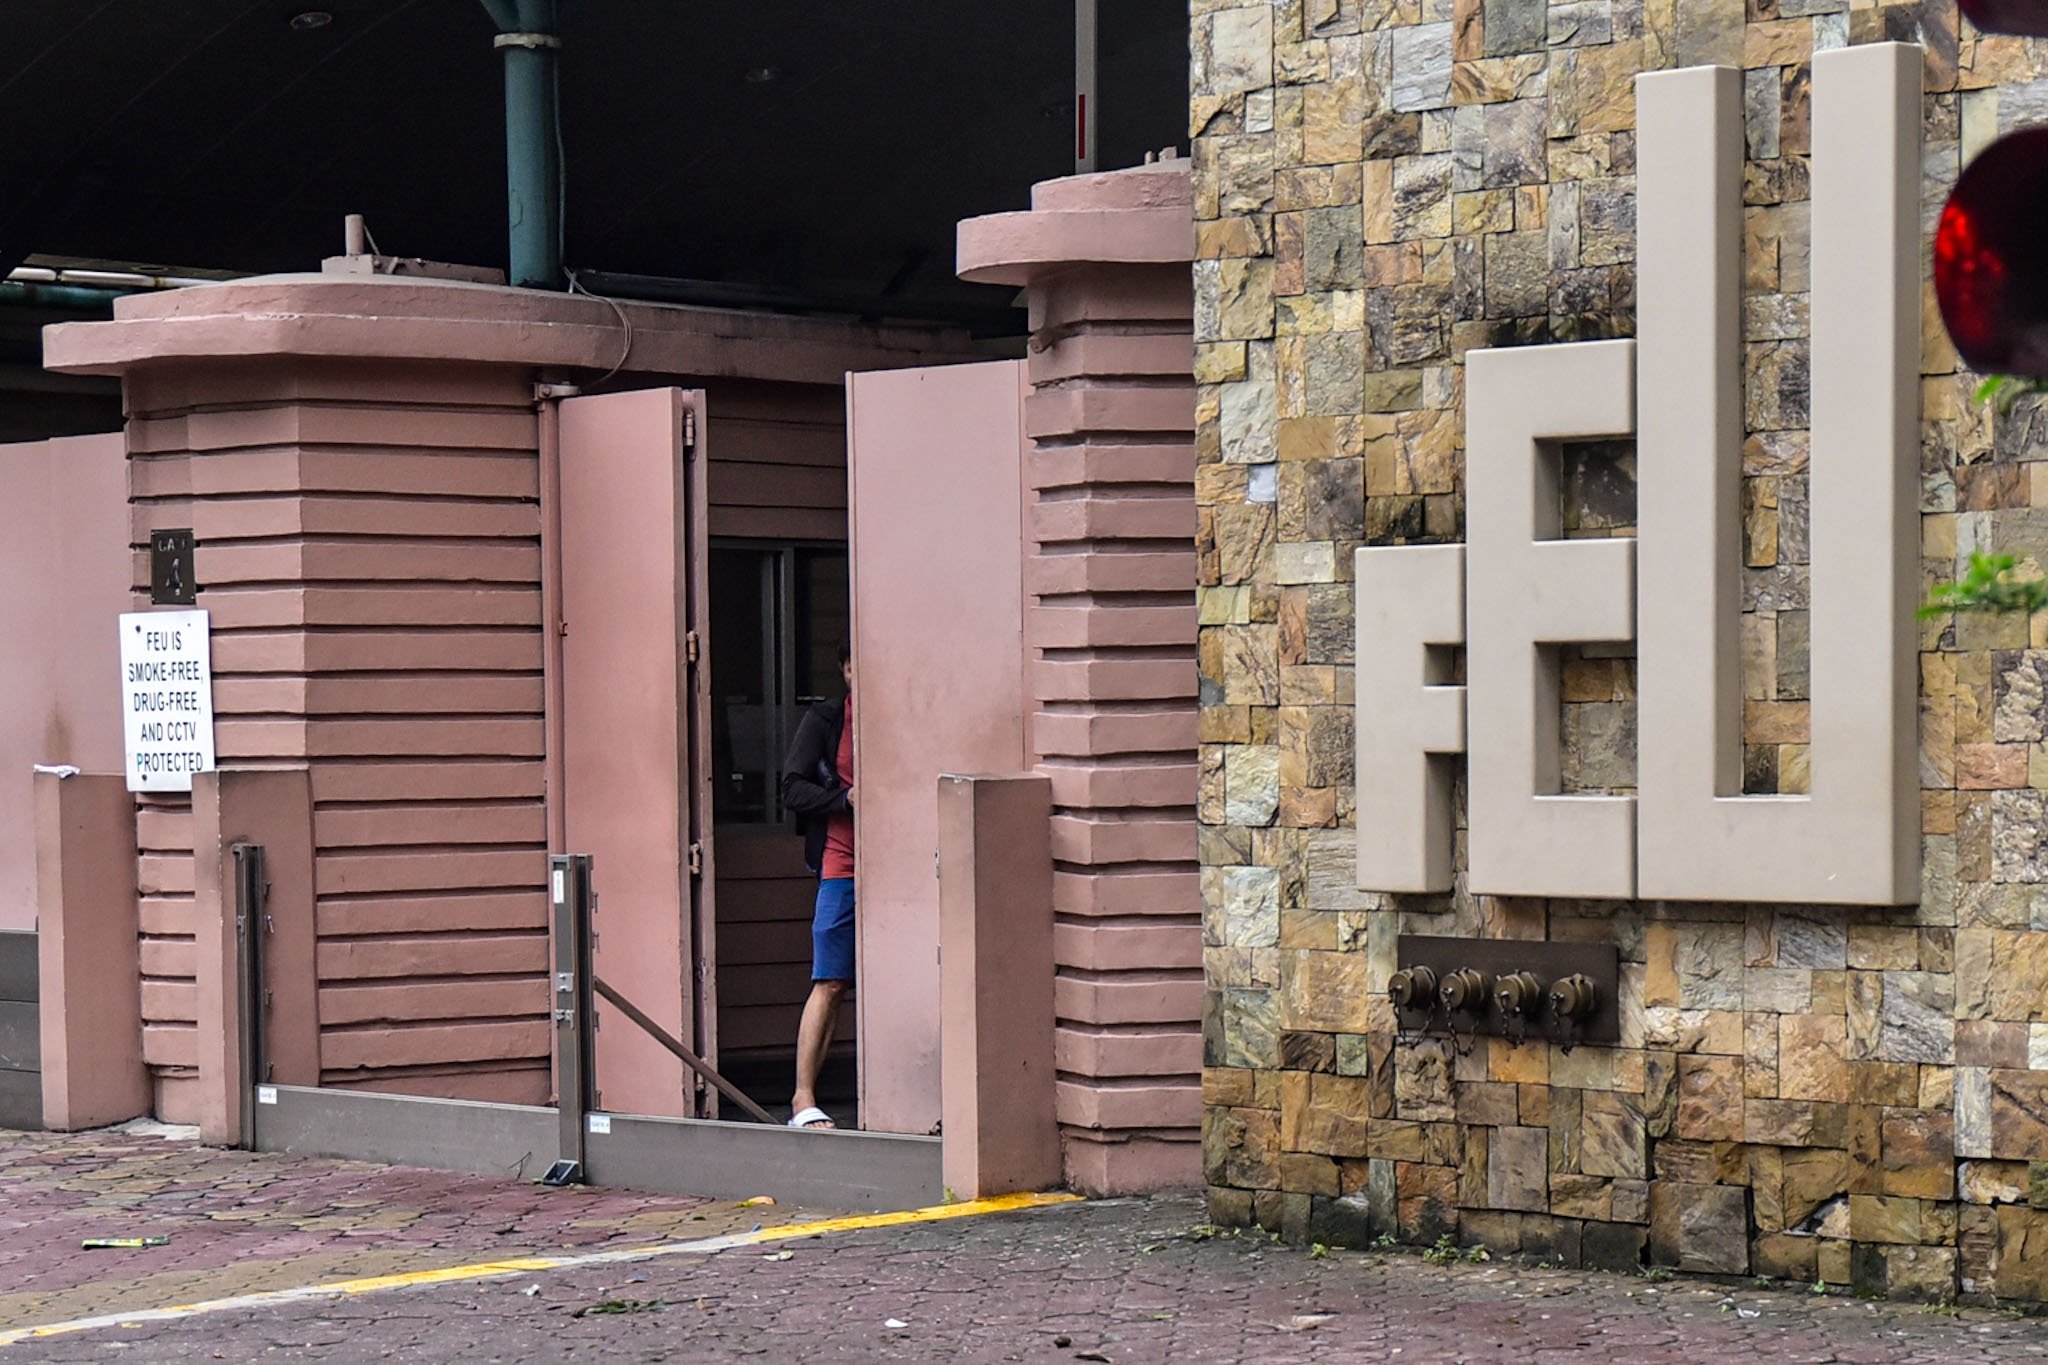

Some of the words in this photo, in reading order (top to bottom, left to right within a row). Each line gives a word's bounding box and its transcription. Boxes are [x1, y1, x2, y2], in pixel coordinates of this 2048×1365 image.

[1355, 40, 1922, 907] FEU
[146, 631, 168, 651] FEU
[171, 630, 182, 651] IS
[128, 660, 204, 684] SMOKE-FREE,
[133, 691, 202, 714] DRUG-FREE,
[140, 721, 163, 742] AND
[167, 721, 196, 741] CCTV
[136, 752, 204, 773] PROTECTED
